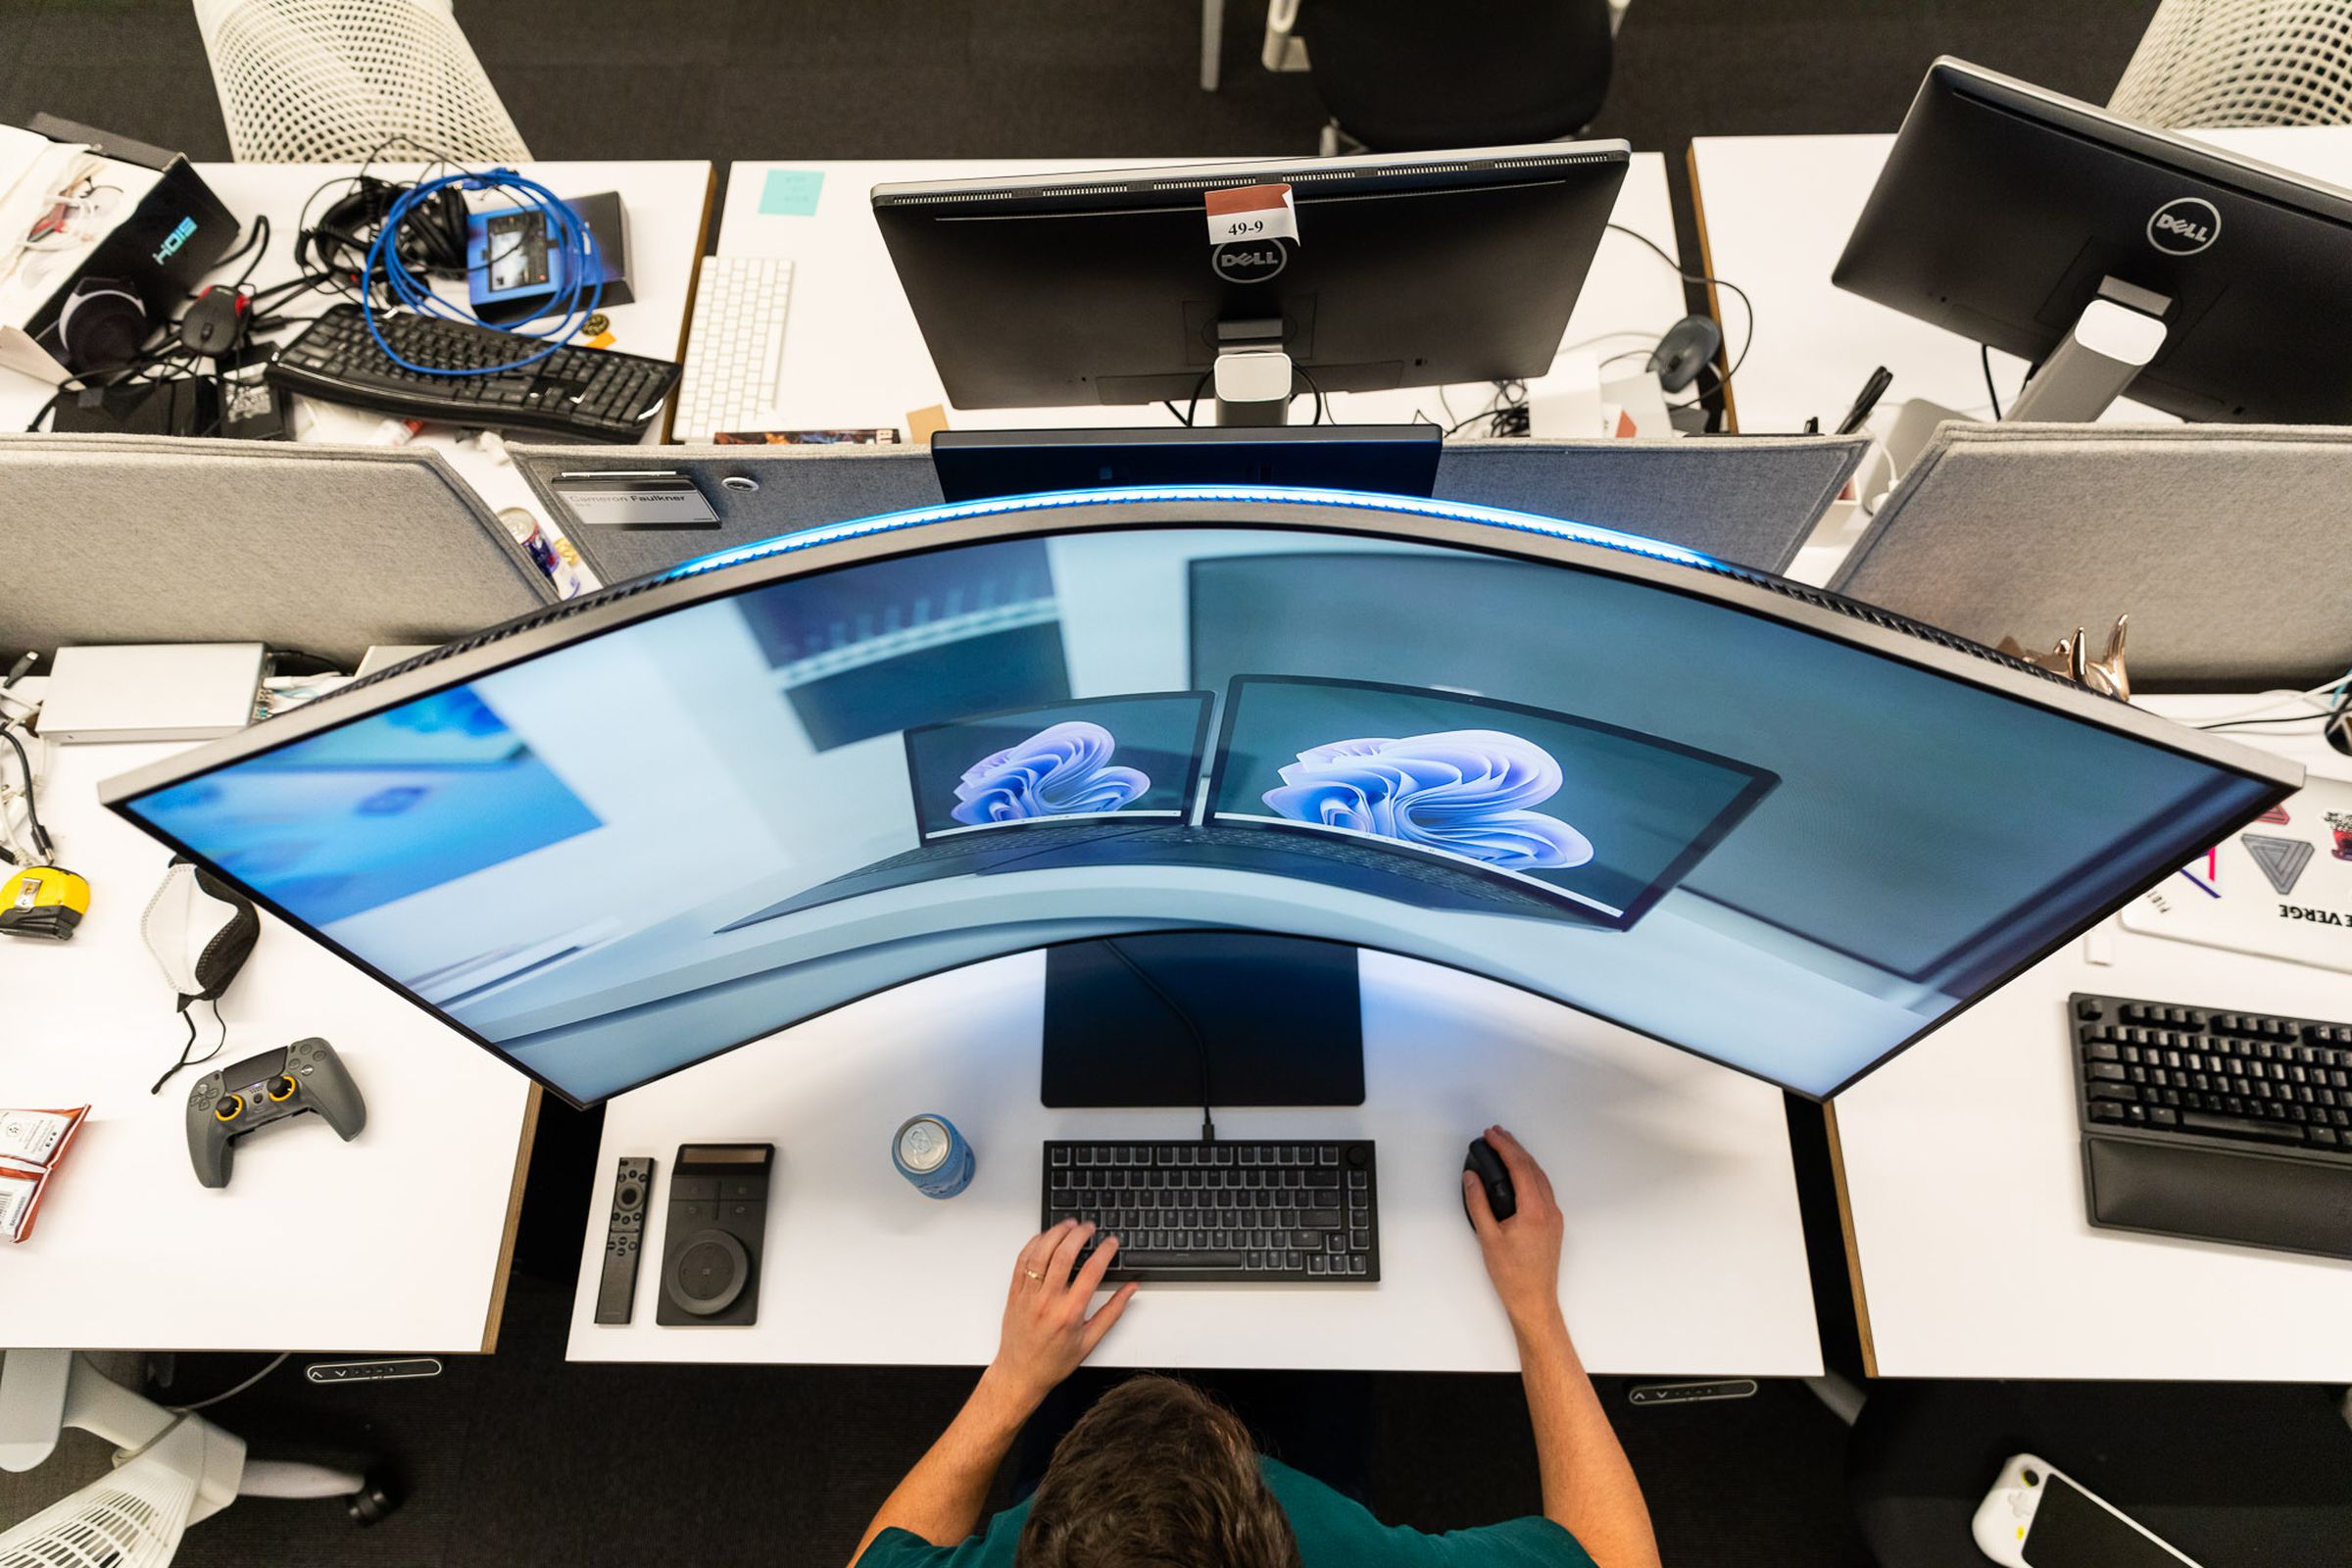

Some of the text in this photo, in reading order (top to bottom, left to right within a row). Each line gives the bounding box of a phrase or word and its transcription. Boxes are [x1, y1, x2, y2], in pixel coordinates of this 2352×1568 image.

[1228, 220, 1264, 236] 49-9
[2156, 213, 2208, 243] DELL
[1221, 251, 1279, 268] DELL
[630, 494, 685, 503] Faulkner
[2278, 904, 2343, 927] VERGE
